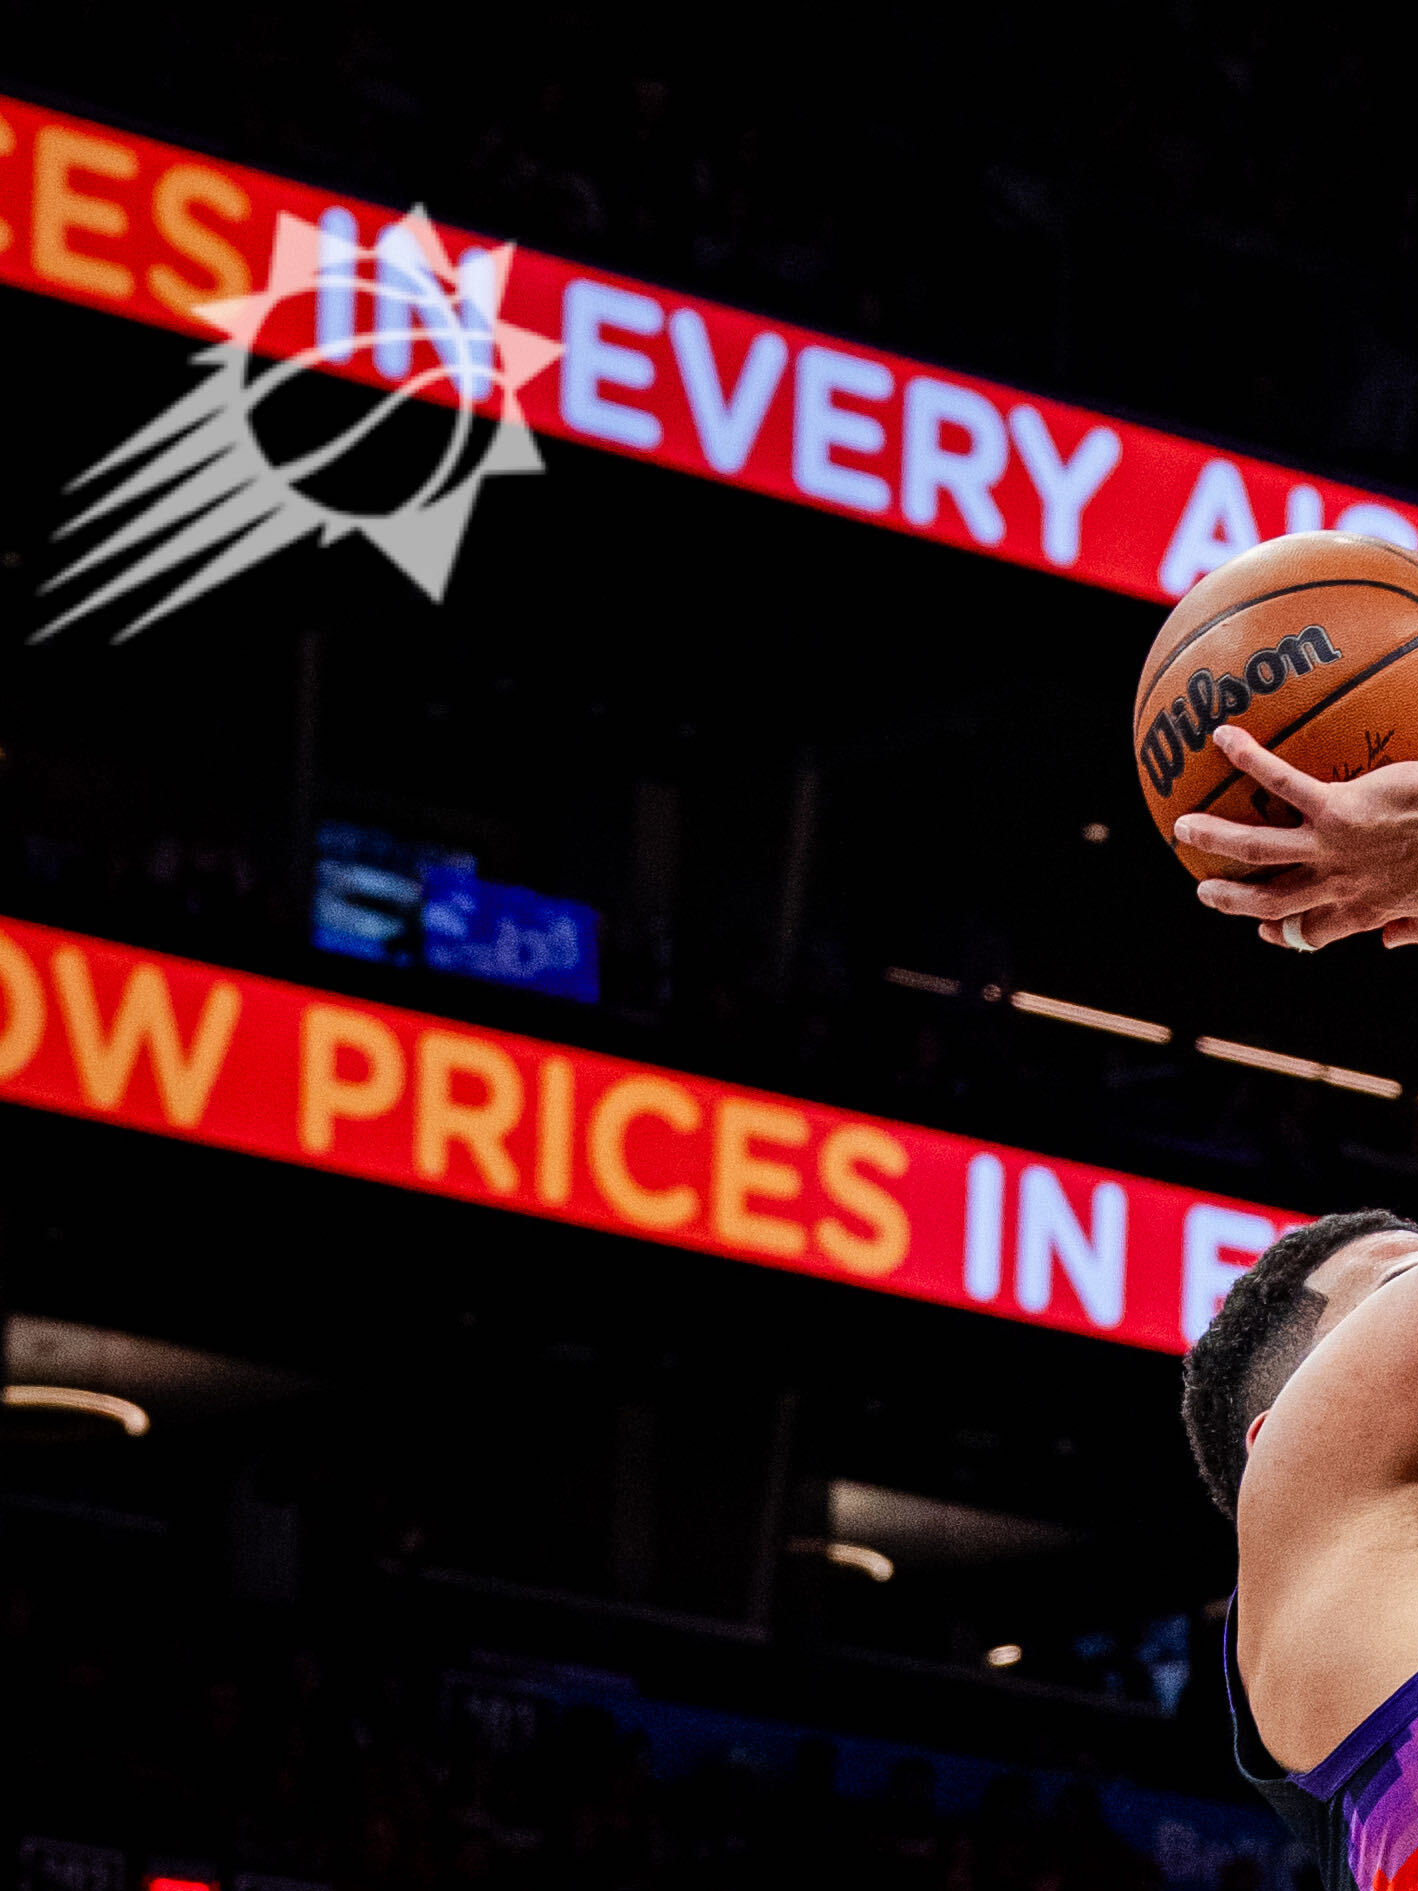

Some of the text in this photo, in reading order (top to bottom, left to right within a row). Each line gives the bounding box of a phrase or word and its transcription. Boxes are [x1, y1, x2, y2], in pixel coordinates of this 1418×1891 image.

[314, 205, 495, 402] IN
[560, 278, 1122, 567] EVERY
[1140, 624, 1342, 798] Wilson
[299, 1004, 911, 1278] PRICES
[963, 1152, 1128, 1329] IN
